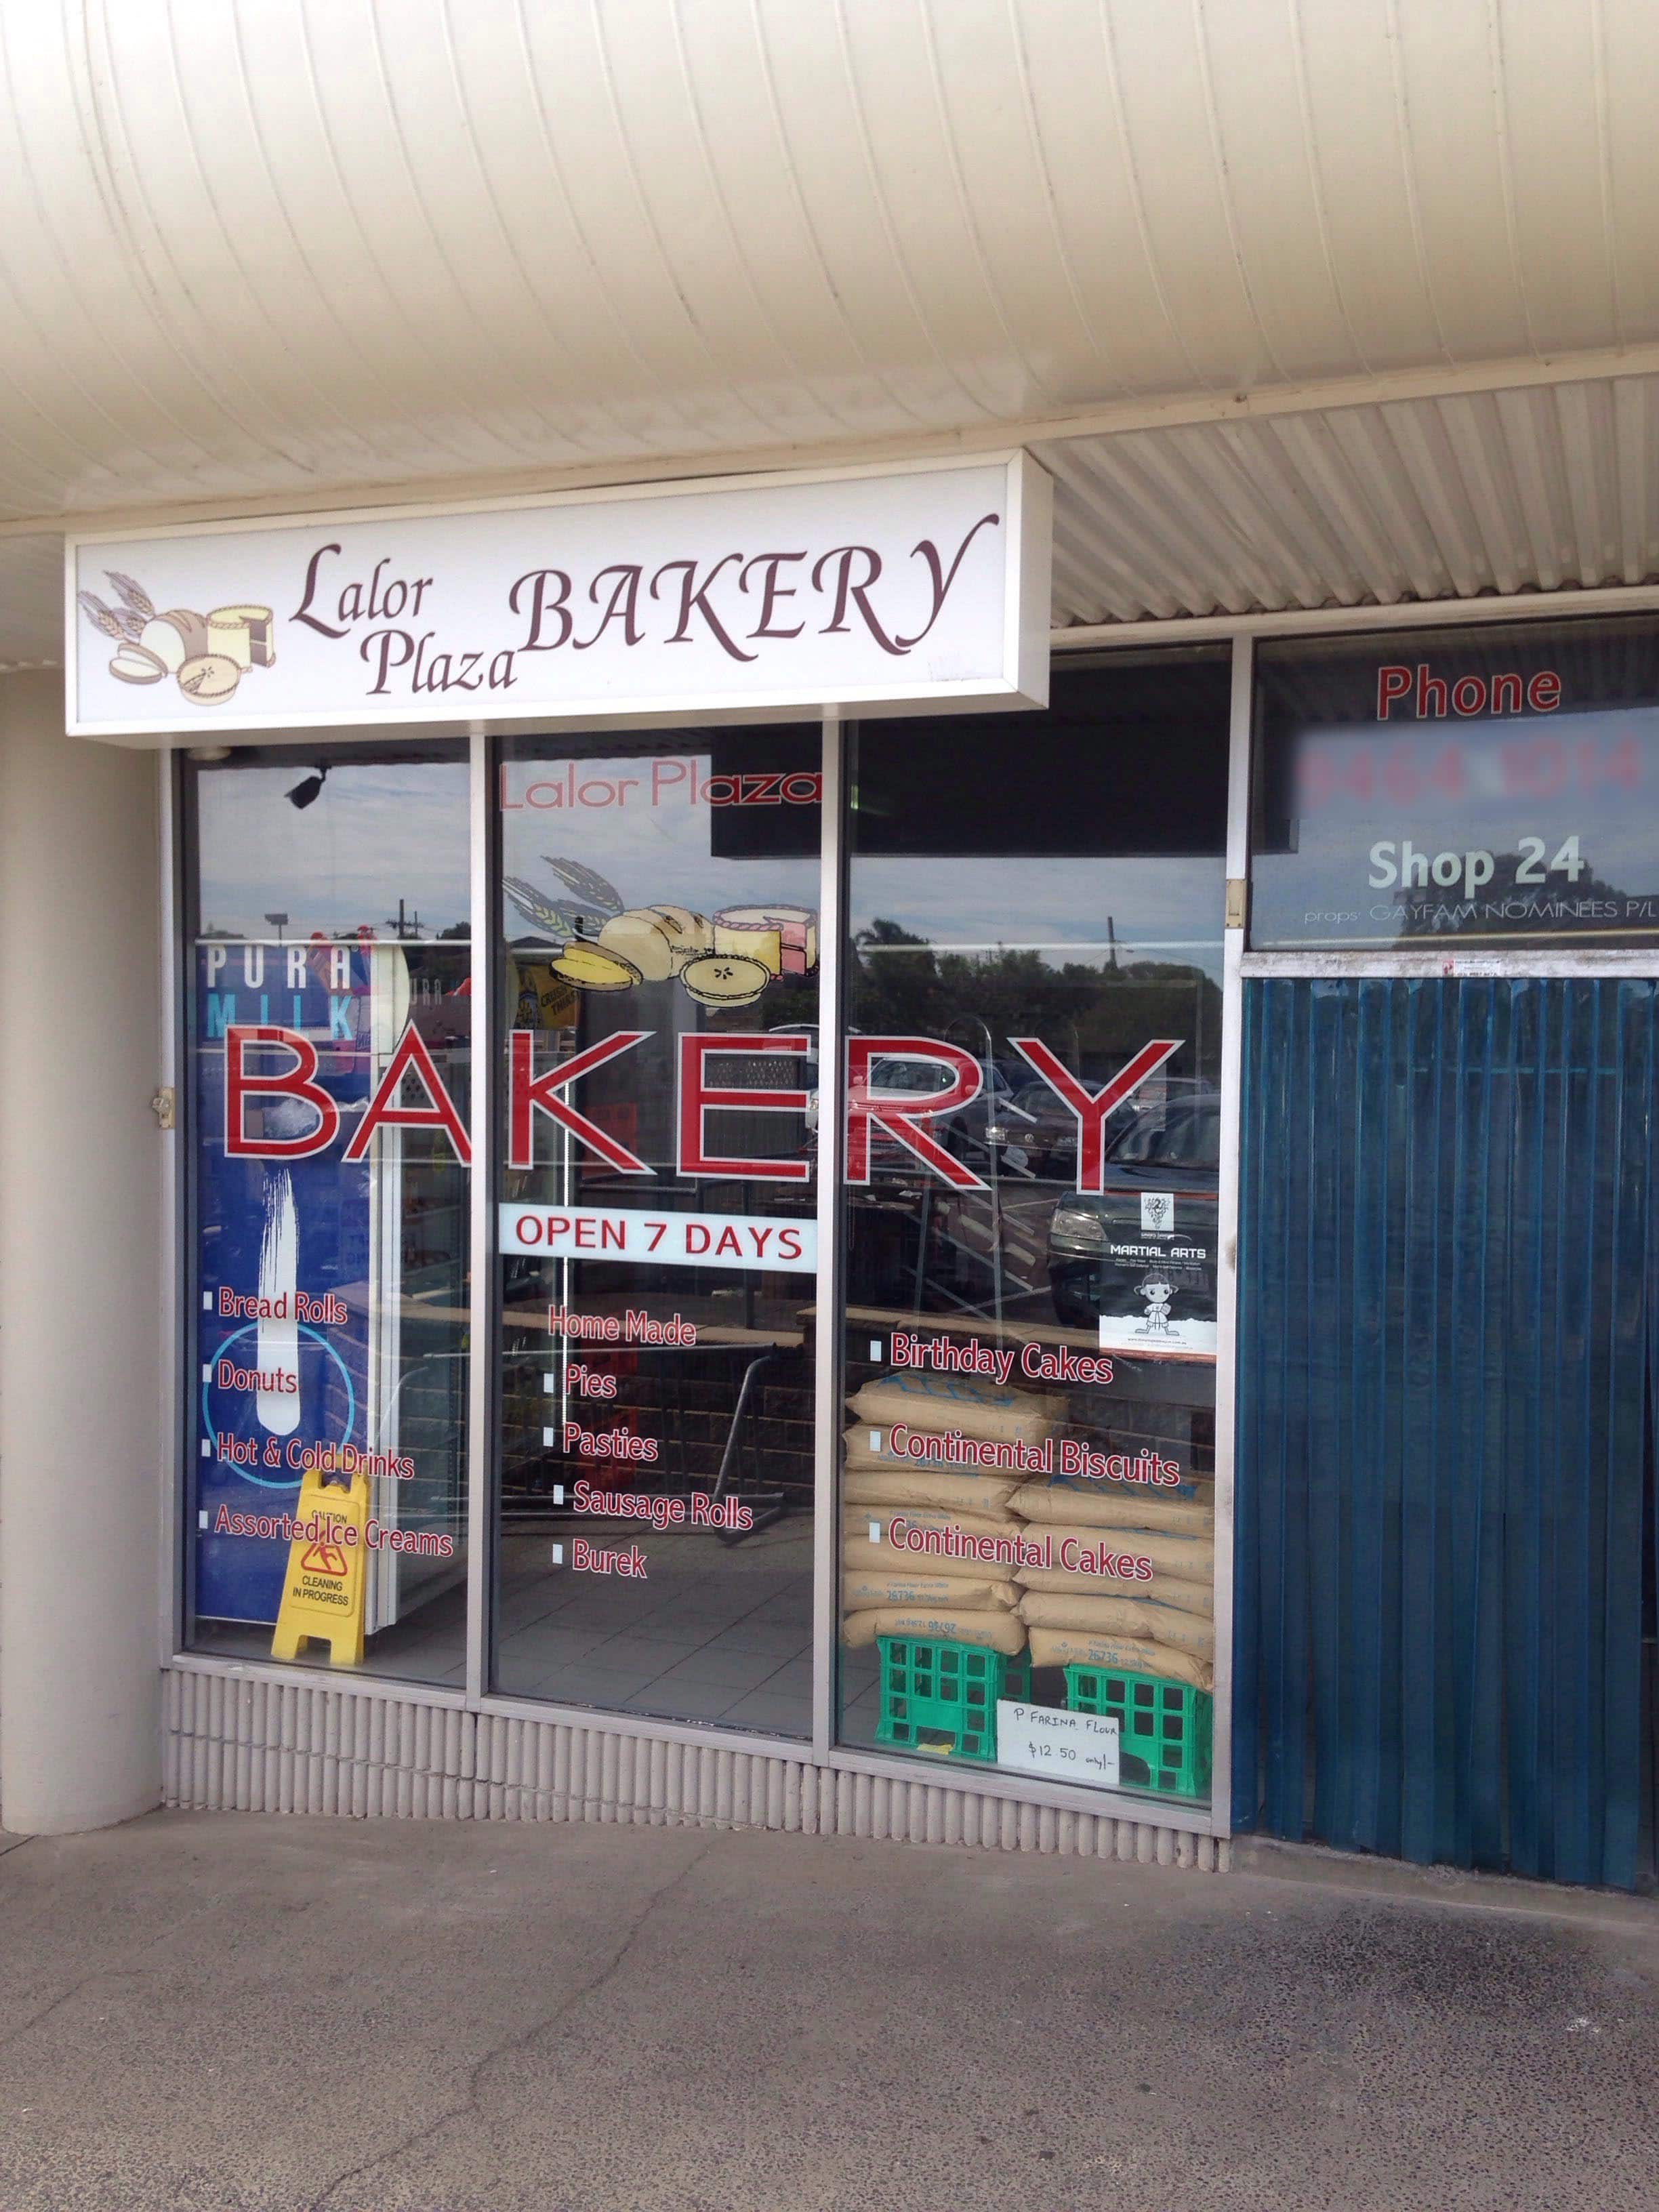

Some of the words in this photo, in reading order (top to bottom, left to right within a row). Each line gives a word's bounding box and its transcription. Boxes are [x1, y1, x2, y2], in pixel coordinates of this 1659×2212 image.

[288, 543, 434, 639] Lalor
[509, 513, 1000, 662] BAKERY
[360, 629, 518, 695] Plaza
[1376, 663, 1561, 720] Phone
[498, 762, 638, 811] Lalor
[651, 759, 822, 807] Plaza
[1368, 840, 1495, 899] Shop
[1515, 836, 1584, 884] 24
[1369, 903, 1477, 922] GAYFAM
[1485, 901, 1618, 920] NOMINEES
[1626, 900, 1658, 919] P/L
[207, 943, 352, 989] PURA
[207, 993, 353, 1041] MILK
[224, 1018, 1186, 1196] BAKERY
[515, 1214, 626, 1250] OPEN
[644, 1223, 667, 1252] 7
[685, 1223, 802, 1261] DAYS
[1110, 1244, 1166, 1258] MARTIAL
[1170, 1247, 1206, 1259] ARTS
[219, 1286, 288, 1319] Bread
[294, 1291, 348, 1324] Rolls
[548, 1304, 620, 1341] Home
[625, 1309, 697, 1347] Made
[218, 1359, 298, 1394] Donuts
[565, 1364, 617, 1399] Pies
[890, 1332, 1015, 1385] Birthday
[1021, 1342, 1113, 1383] Cakes
[217, 1431, 259, 1466] Hot
[263, 1436, 281, 1468] &
[286, 1437, 337, 1473] Cold
[341, 1443, 415, 1480] Drinks
[562, 1422, 659, 1462] Pasties
[889, 1422, 1053, 1474] Continental
[1060, 1439, 1181, 1488] Biscuits
[573, 1480, 686, 1530] Sausage
[691, 1492, 754, 1531] Rolls
[214, 1504, 320, 1544] Assorted
[325, 1515, 359, 1547] Ice
[364, 1519, 454, 1558] Creams
[888, 1516, 1052, 1569] Continental
[1059, 1537, 1154, 1582] Cakes
[572, 1538, 648, 1578] Burek
[293, 1587, 302, 1598] IN
[302, 1589, 350, 1607] PROGRESS
[302, 1575, 343, 1592] CLEANING
[1013, 1707, 1025, 1721] P
[1030, 1710, 1076, 1727] FARINA
[1086, 1719, 1118, 1735] FLOUR
